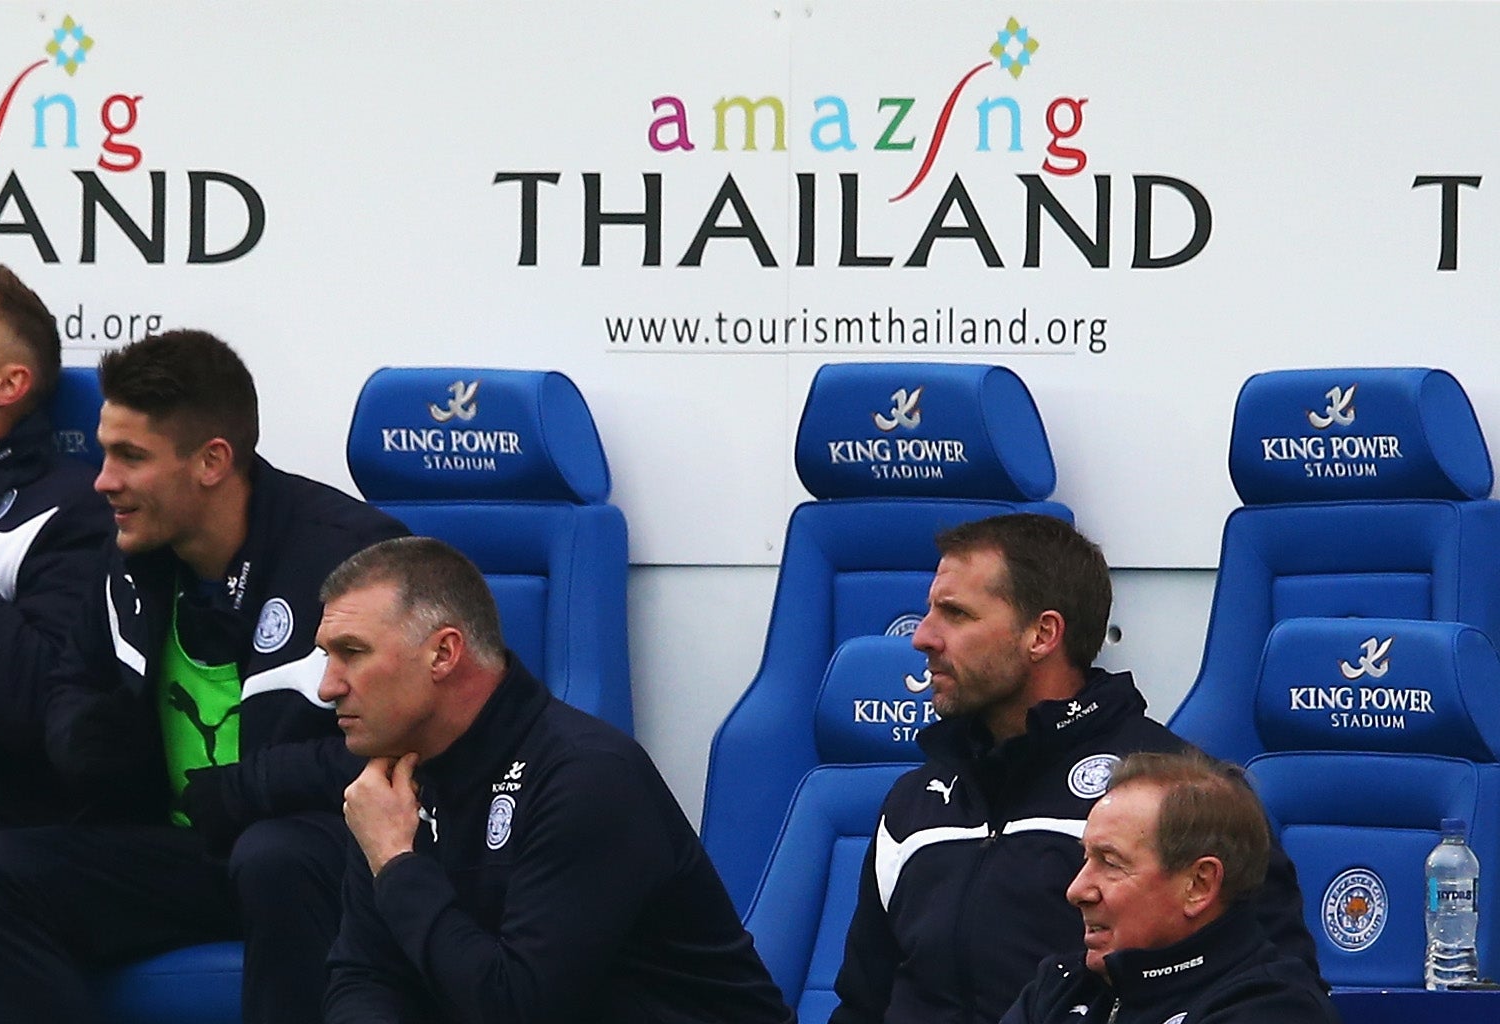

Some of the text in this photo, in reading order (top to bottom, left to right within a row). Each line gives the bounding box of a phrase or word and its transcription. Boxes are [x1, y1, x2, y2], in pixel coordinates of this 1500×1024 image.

[494, 173, 1214, 270] THAILAND
[604, 307, 1108, 354] www.tourismthailand.org
[382, 428, 523, 455] KING POWER
[828, 439, 968, 464] KING POWER
[1261, 436, 1403, 461] KING POWER
[423, 455, 496, 471] STADIUM
[871, 464, 943, 479] STADIUM
[1304, 462, 1377, 478] STADIUM
[1290, 687, 1435, 713] KING POWER
[854, 701, 917, 724] KING
[1331, 713, 1405, 729] STADIUM
[1142, 966, 1173, 979] TOYO
